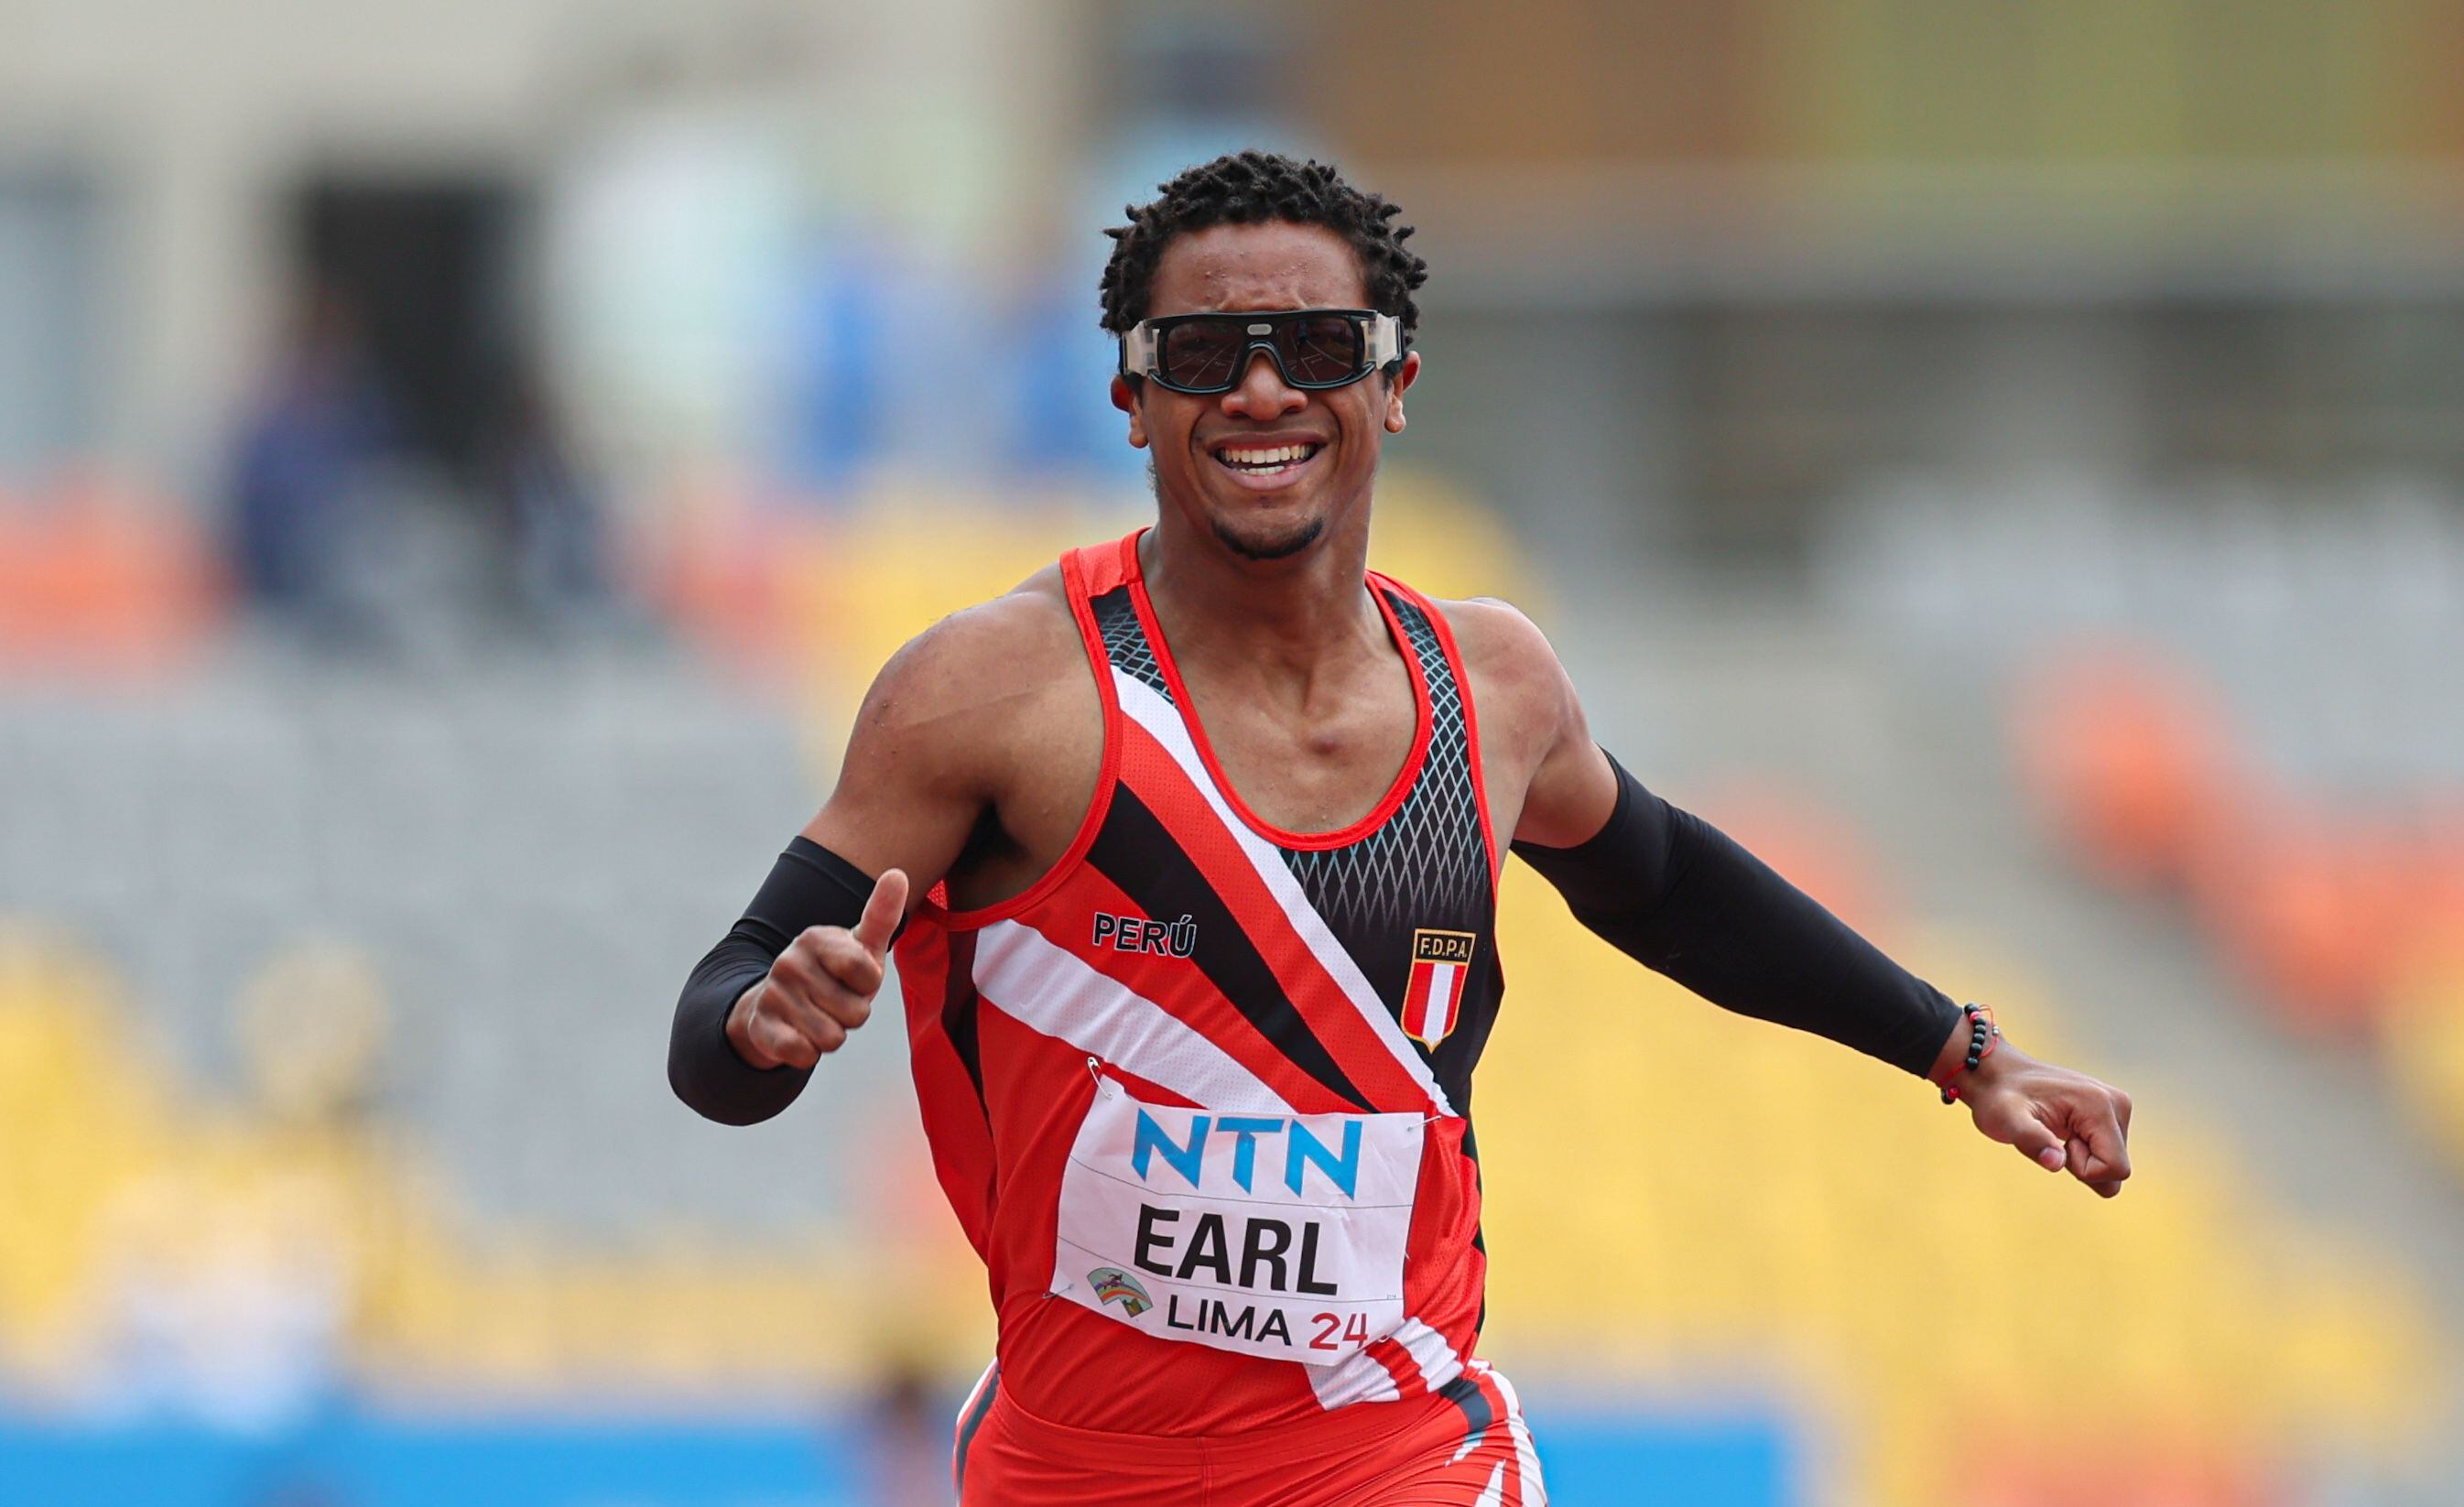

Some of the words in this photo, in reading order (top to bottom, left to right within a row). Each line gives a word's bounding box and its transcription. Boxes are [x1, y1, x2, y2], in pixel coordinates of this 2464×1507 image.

[1092, 912, 1197, 958] PERÚ
[1132, 1108, 1362, 1201] NTN
[1134, 1203, 1337, 1296] EARL
[1167, 1295, 1291, 1346] LIMA
[1308, 1312, 1368, 1350] 24
